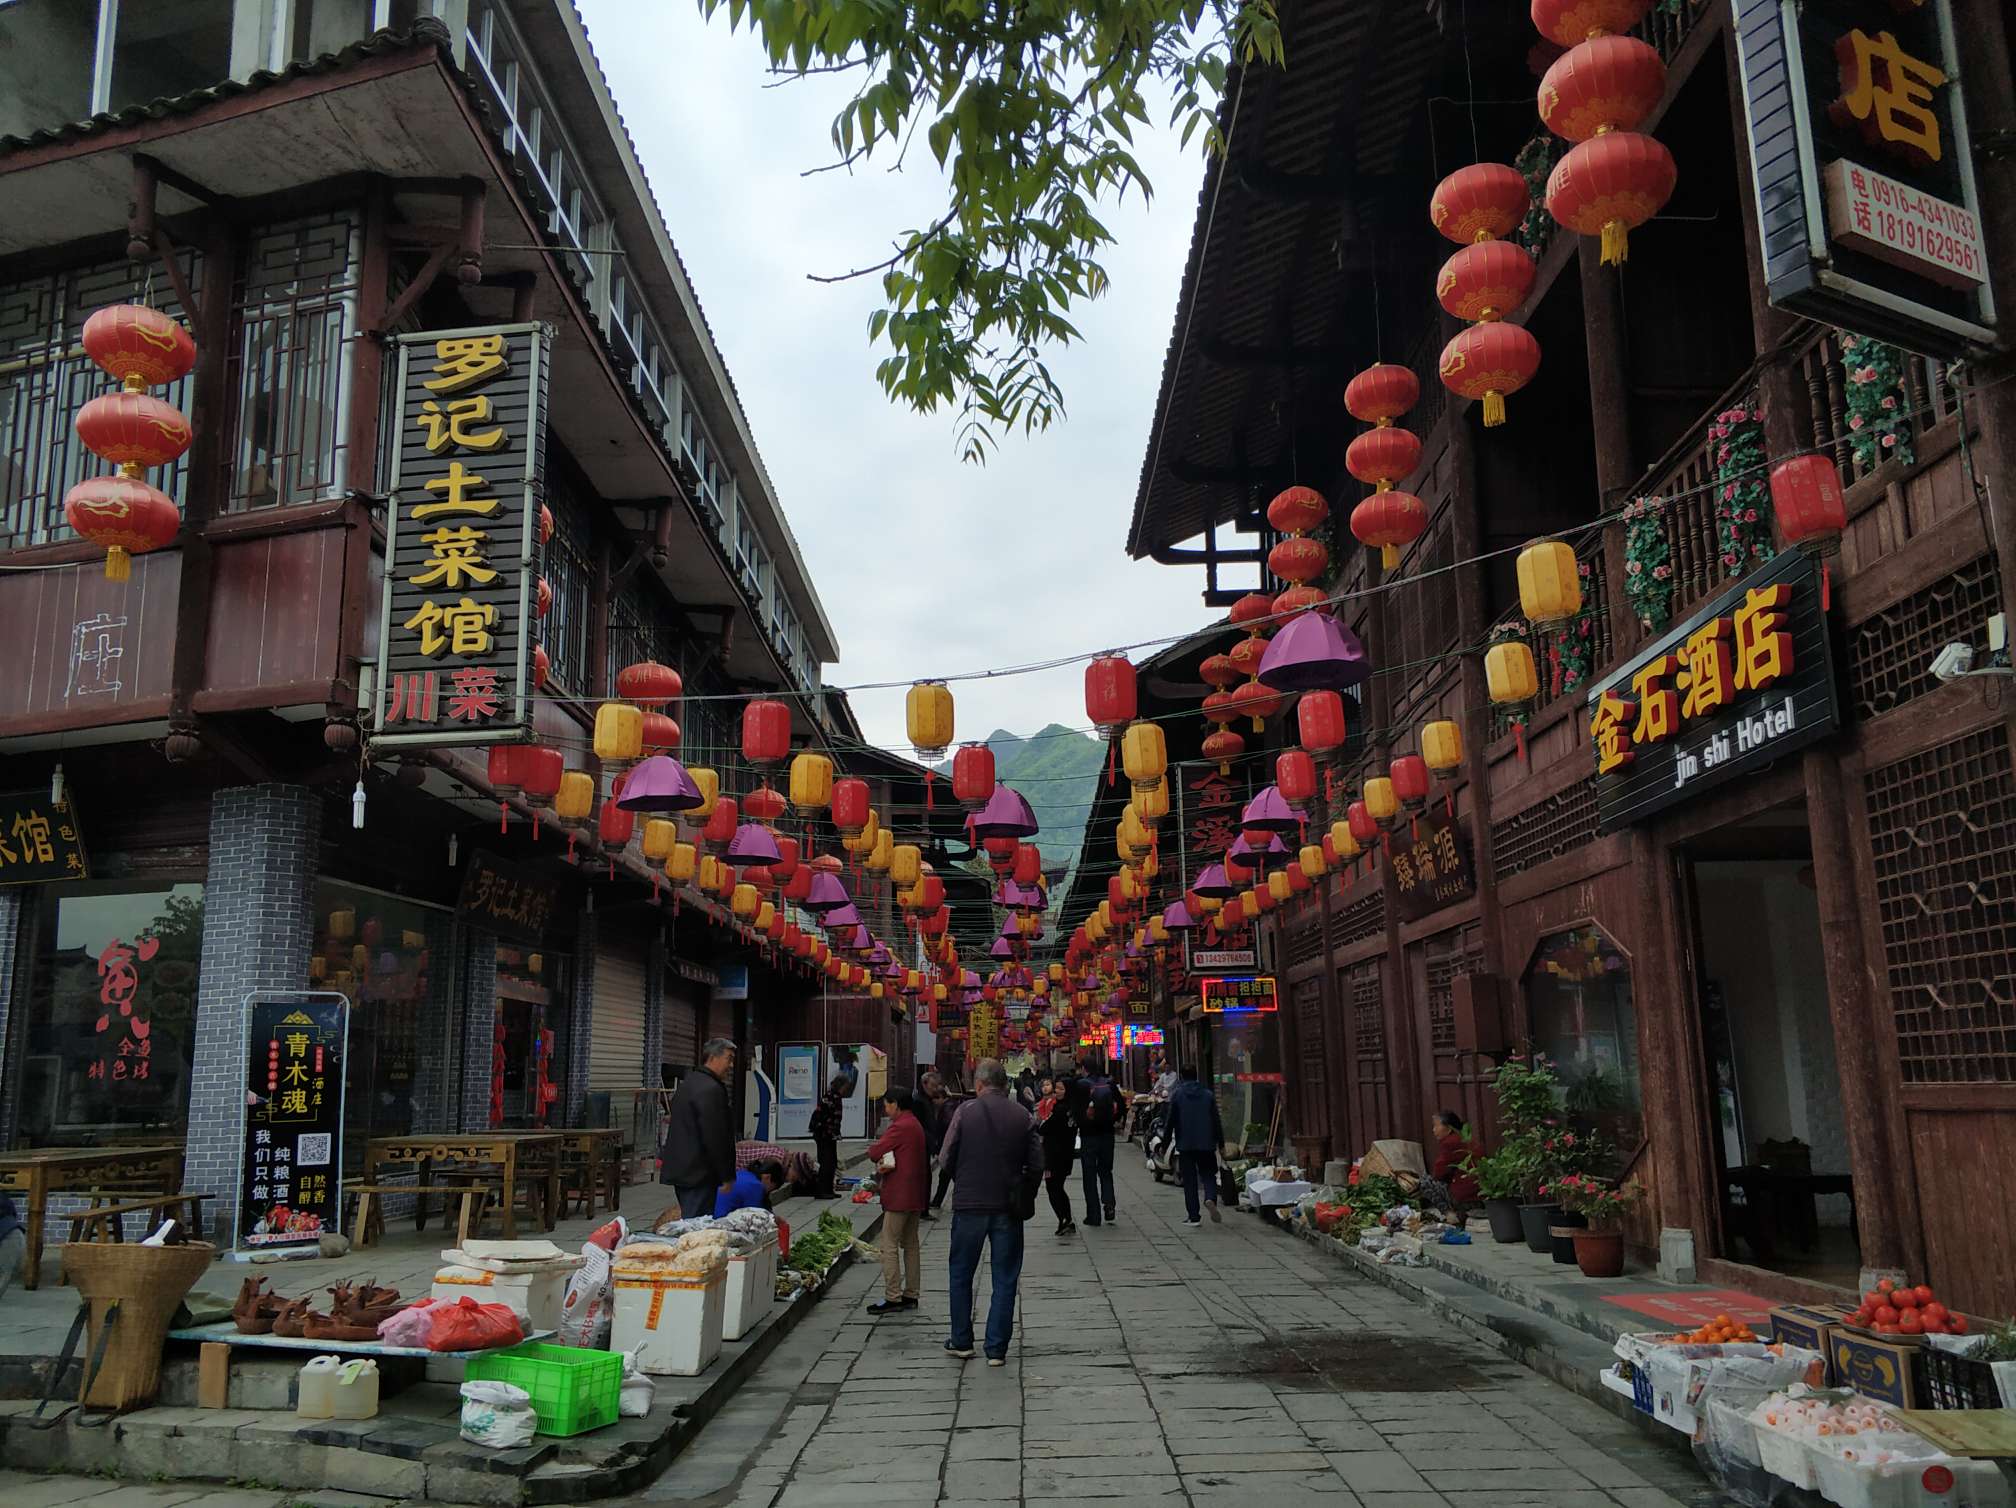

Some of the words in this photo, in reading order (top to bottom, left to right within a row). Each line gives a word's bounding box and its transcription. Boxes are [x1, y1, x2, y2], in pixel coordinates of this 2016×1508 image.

[1846, 0, 1947, 161] 店
[1872, 175, 1976, 241] 0916-4341033
[1876, 209, 1981, 274] 18191629561
[404, 334, 508, 657] 罗记土菜馆
[386, 667, 499, 722] 川菜
[1590, 583, 1790, 774] 金石酒店
[1675, 750, 1699, 788] jin
[1704, 730, 1731, 767] shi
[1737, 696, 1796, 753] Hotel
[281, 1032, 311, 1114] 青木魂
[252, 1129, 272, 1200] 我们只做
[272, 1147, 291, 1204] 纯粮酒
